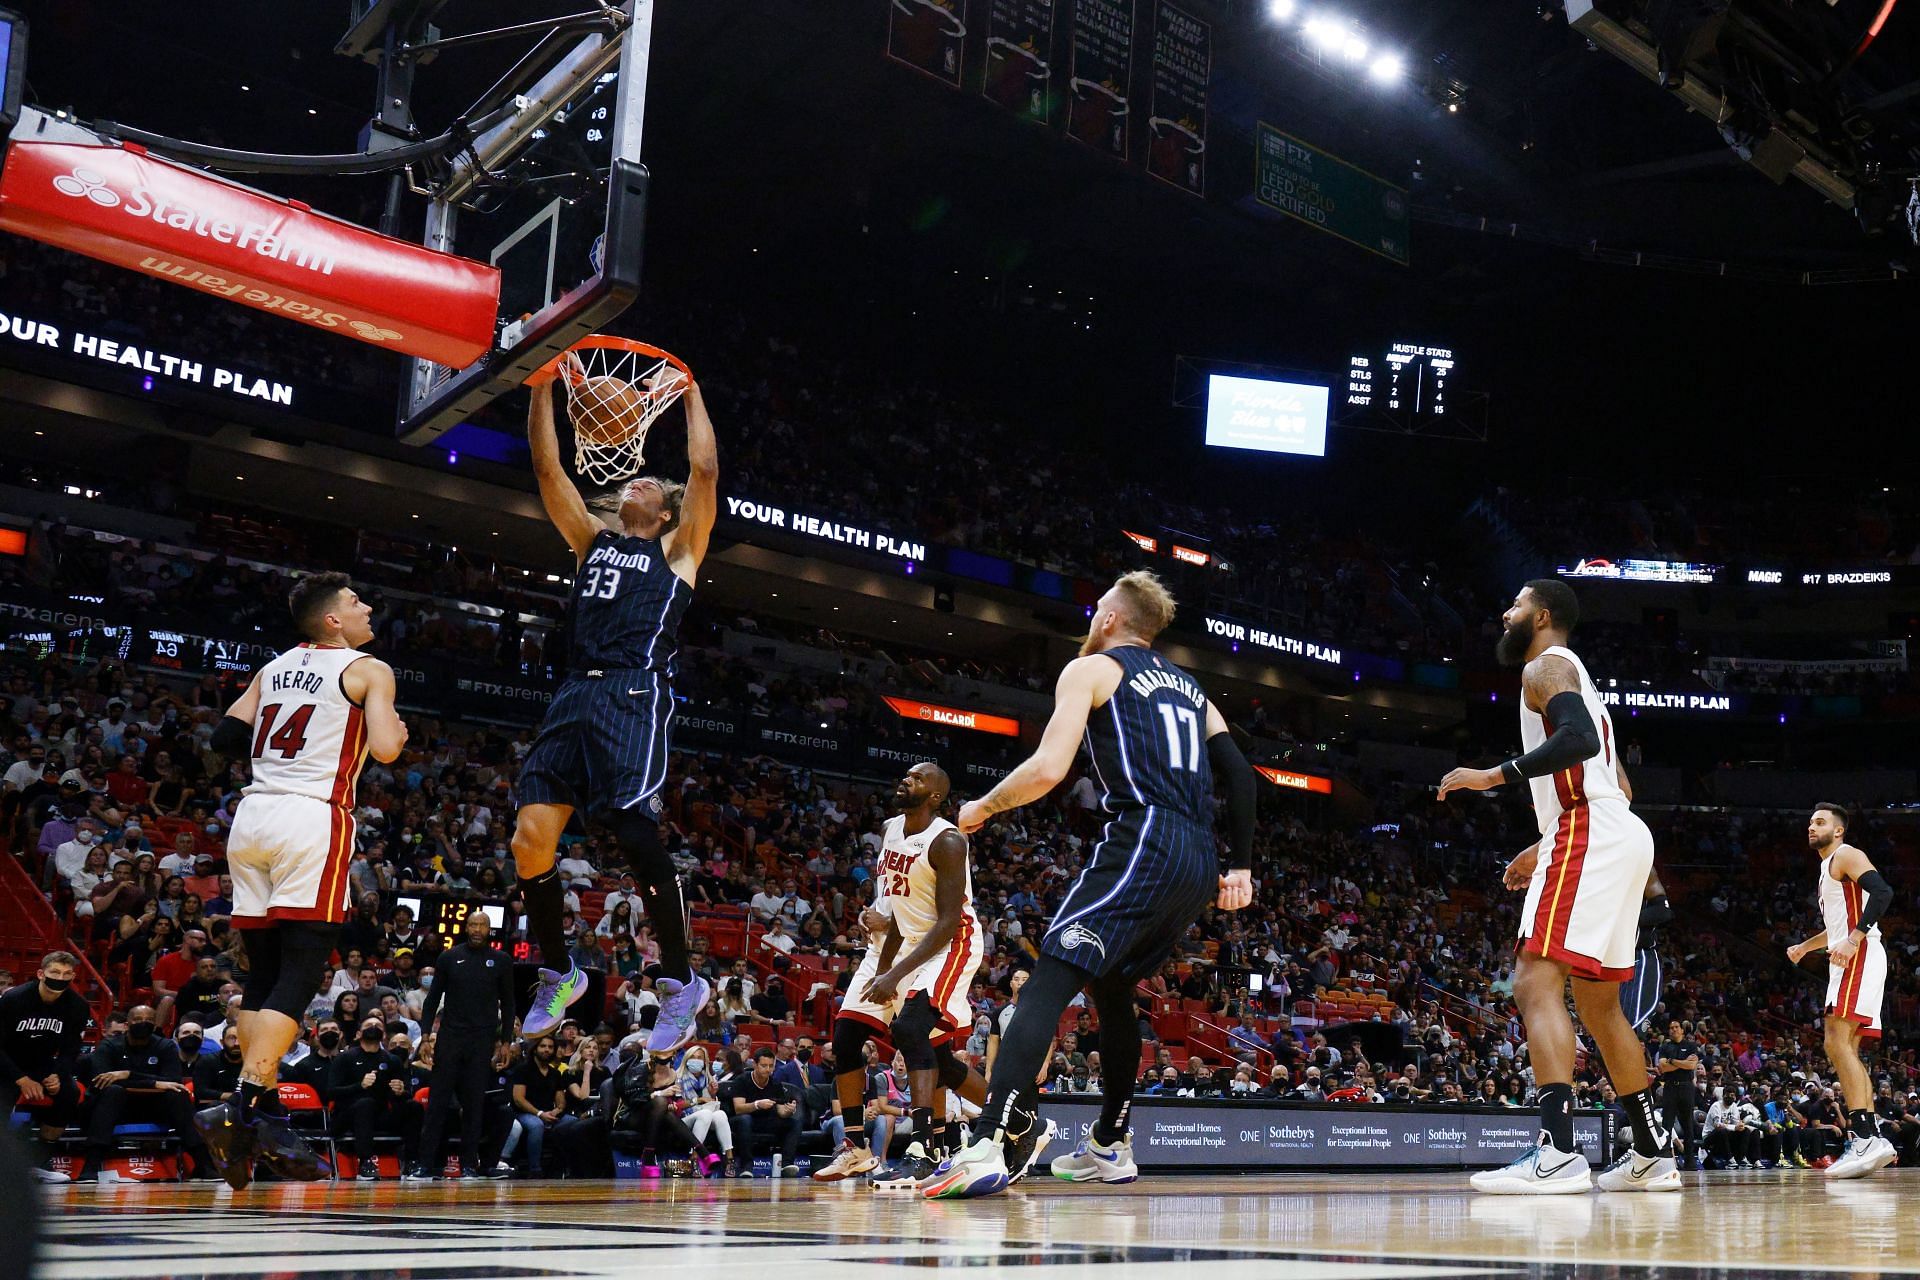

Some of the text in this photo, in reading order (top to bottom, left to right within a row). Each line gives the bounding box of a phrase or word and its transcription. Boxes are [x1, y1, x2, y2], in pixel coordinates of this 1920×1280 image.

[1288, 144, 1312, 163] FTX
[1263, 168, 1335, 212] LEED GOLD
[0, 313, 293, 405] OUR HEALTH PLAN
[1393, 344, 1452, 358] HUSTLE STATS
[1351, 357, 1447, 376] REB 30 25
[1350, 370, 1443, 389] STLS 7 5
[1349, 382, 1442, 401] BLKS 2 4
[1348, 395, 1444, 414] ASST 18 15
[727, 497, 925, 561] YOUR HEALTH PLAN
[1575, 558, 1620, 577] Acordis
[1677, 573, 1713, 583] Solutions
[1748, 570, 1782, 583] MAGIC
[1802, 572, 1891, 584] #17 BRAZDEIKIS
[581, 567, 621, 599] 33
[39, 608, 106, 630] arena
[1205, 617, 1341, 664] YOUR HEALTH PLAN
[272, 670, 323, 694] HERRO
[396, 667, 425, 682] ena
[474, 681, 552, 703] FTX arena
[1129, 669, 1205, 709] BRAZDEIKIS
[1600, 692, 1730, 709] UR HEALTH PLAN
[675, 715, 734, 733] TX arena
[933, 710, 976, 728] BACARDÍ
[252, 703, 317, 759] 14
[1158, 703, 1200, 773] 17
[774, 731, 838, 750] FTX arena
[879, 749, 901, 760] FTX
[977, 766, 1000, 777] FTX
[1276, 774, 1308, 789] BACARDÍ
[884, 849, 921, 875] HEAT
[892, 874, 910, 897] 21
[1155, 1123, 1221, 1135] Exceptional Homes
[1239, 1130, 1260, 1142] ONE
[1269, 1126, 1315, 1141] Sotheby's
[1332, 1126, 1388, 1136] Exceptional Homes
[1428, 1128, 1467, 1142] Sotheby's
[1481, 1128, 1530, 1138] Exceptional Homes
[1574, 1131, 1598, 1142] theby's
[1150, 1137, 1226, 1148] for Exceptional People
[1327, 1139, 1392, 1149] for Exceptional People
[1403, 1133, 1421, 1144] ONE
[1478, 1140, 1534, 1150] for Exceptional People
